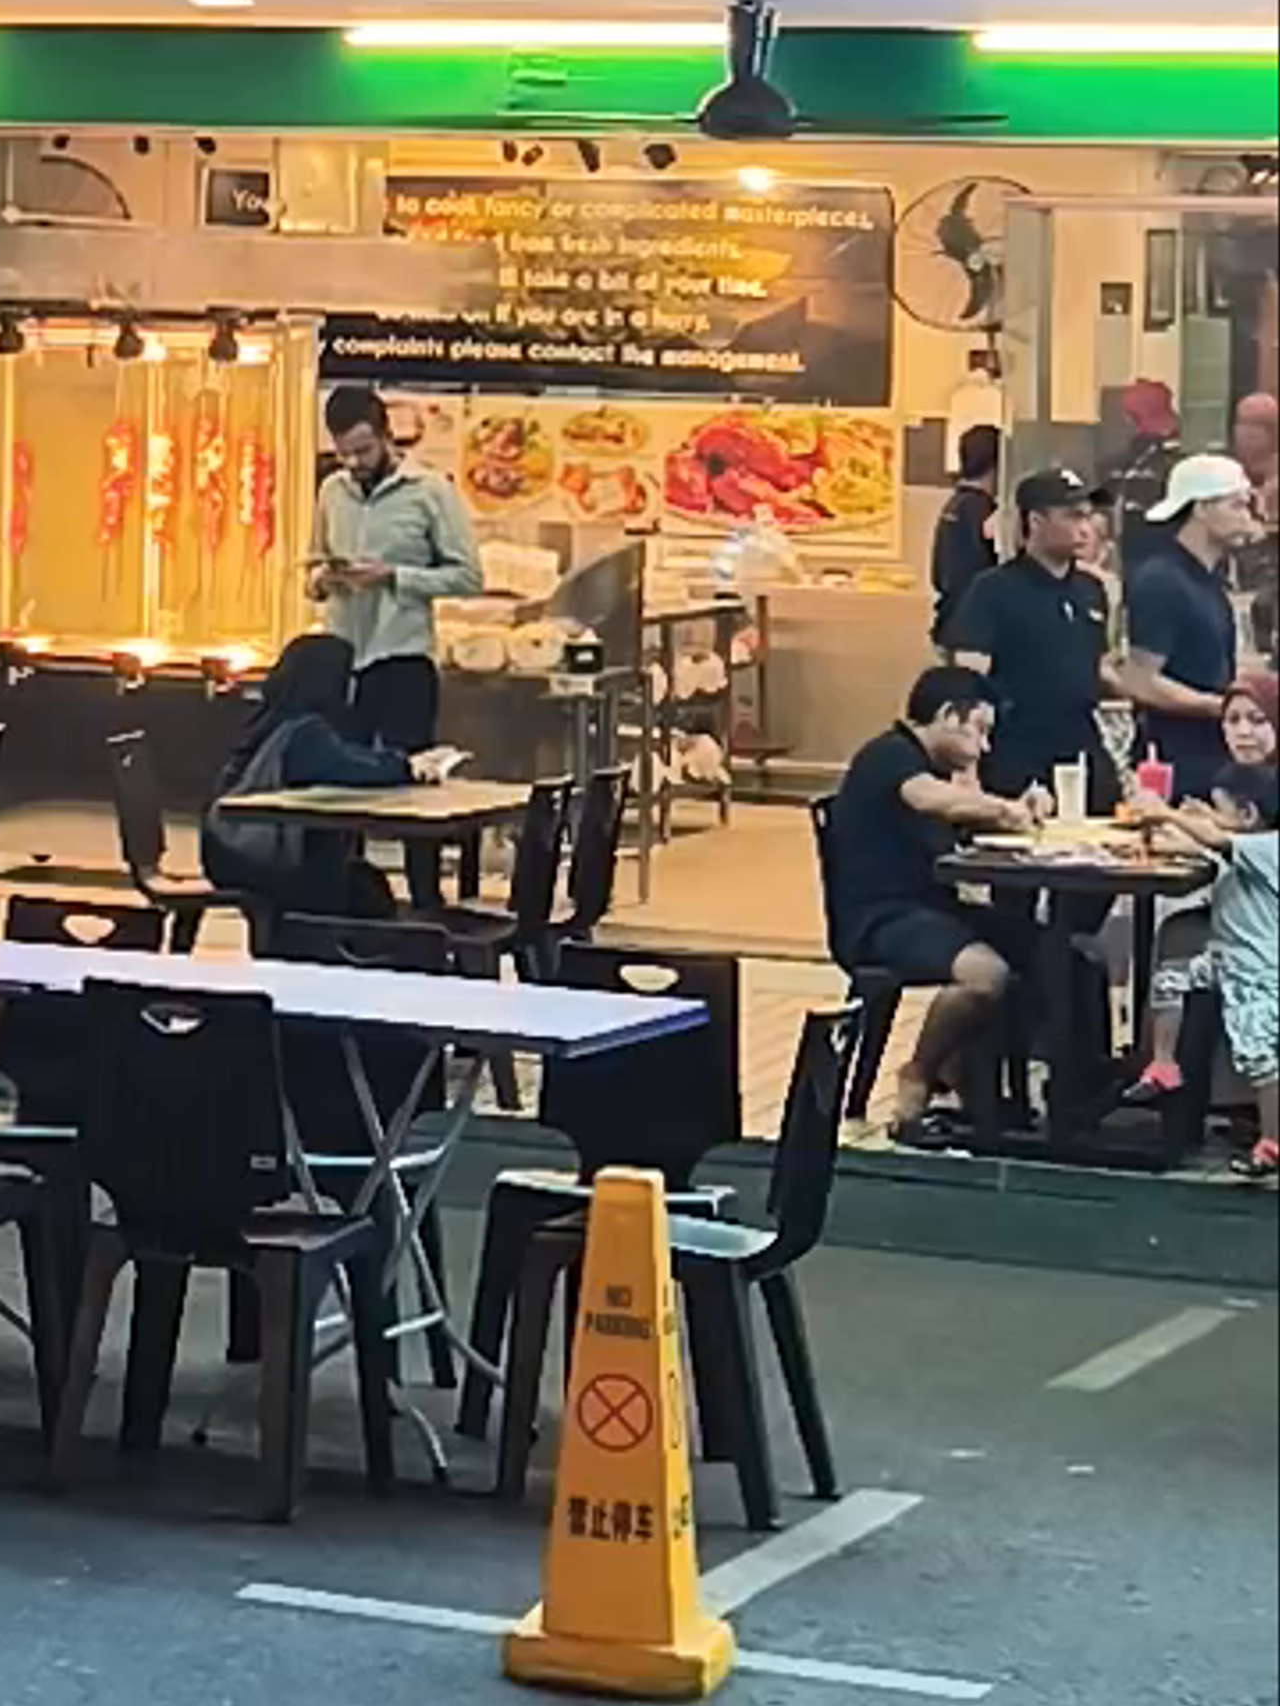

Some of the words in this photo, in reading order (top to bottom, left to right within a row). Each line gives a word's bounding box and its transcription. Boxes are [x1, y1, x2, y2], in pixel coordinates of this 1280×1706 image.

[485, 195, 544, 220] fancy
[551, 200, 577, 218] or
[581, 198, 718, 224] complicated
[516, 307, 558, 328] you
[449, 337, 522, 363] please
